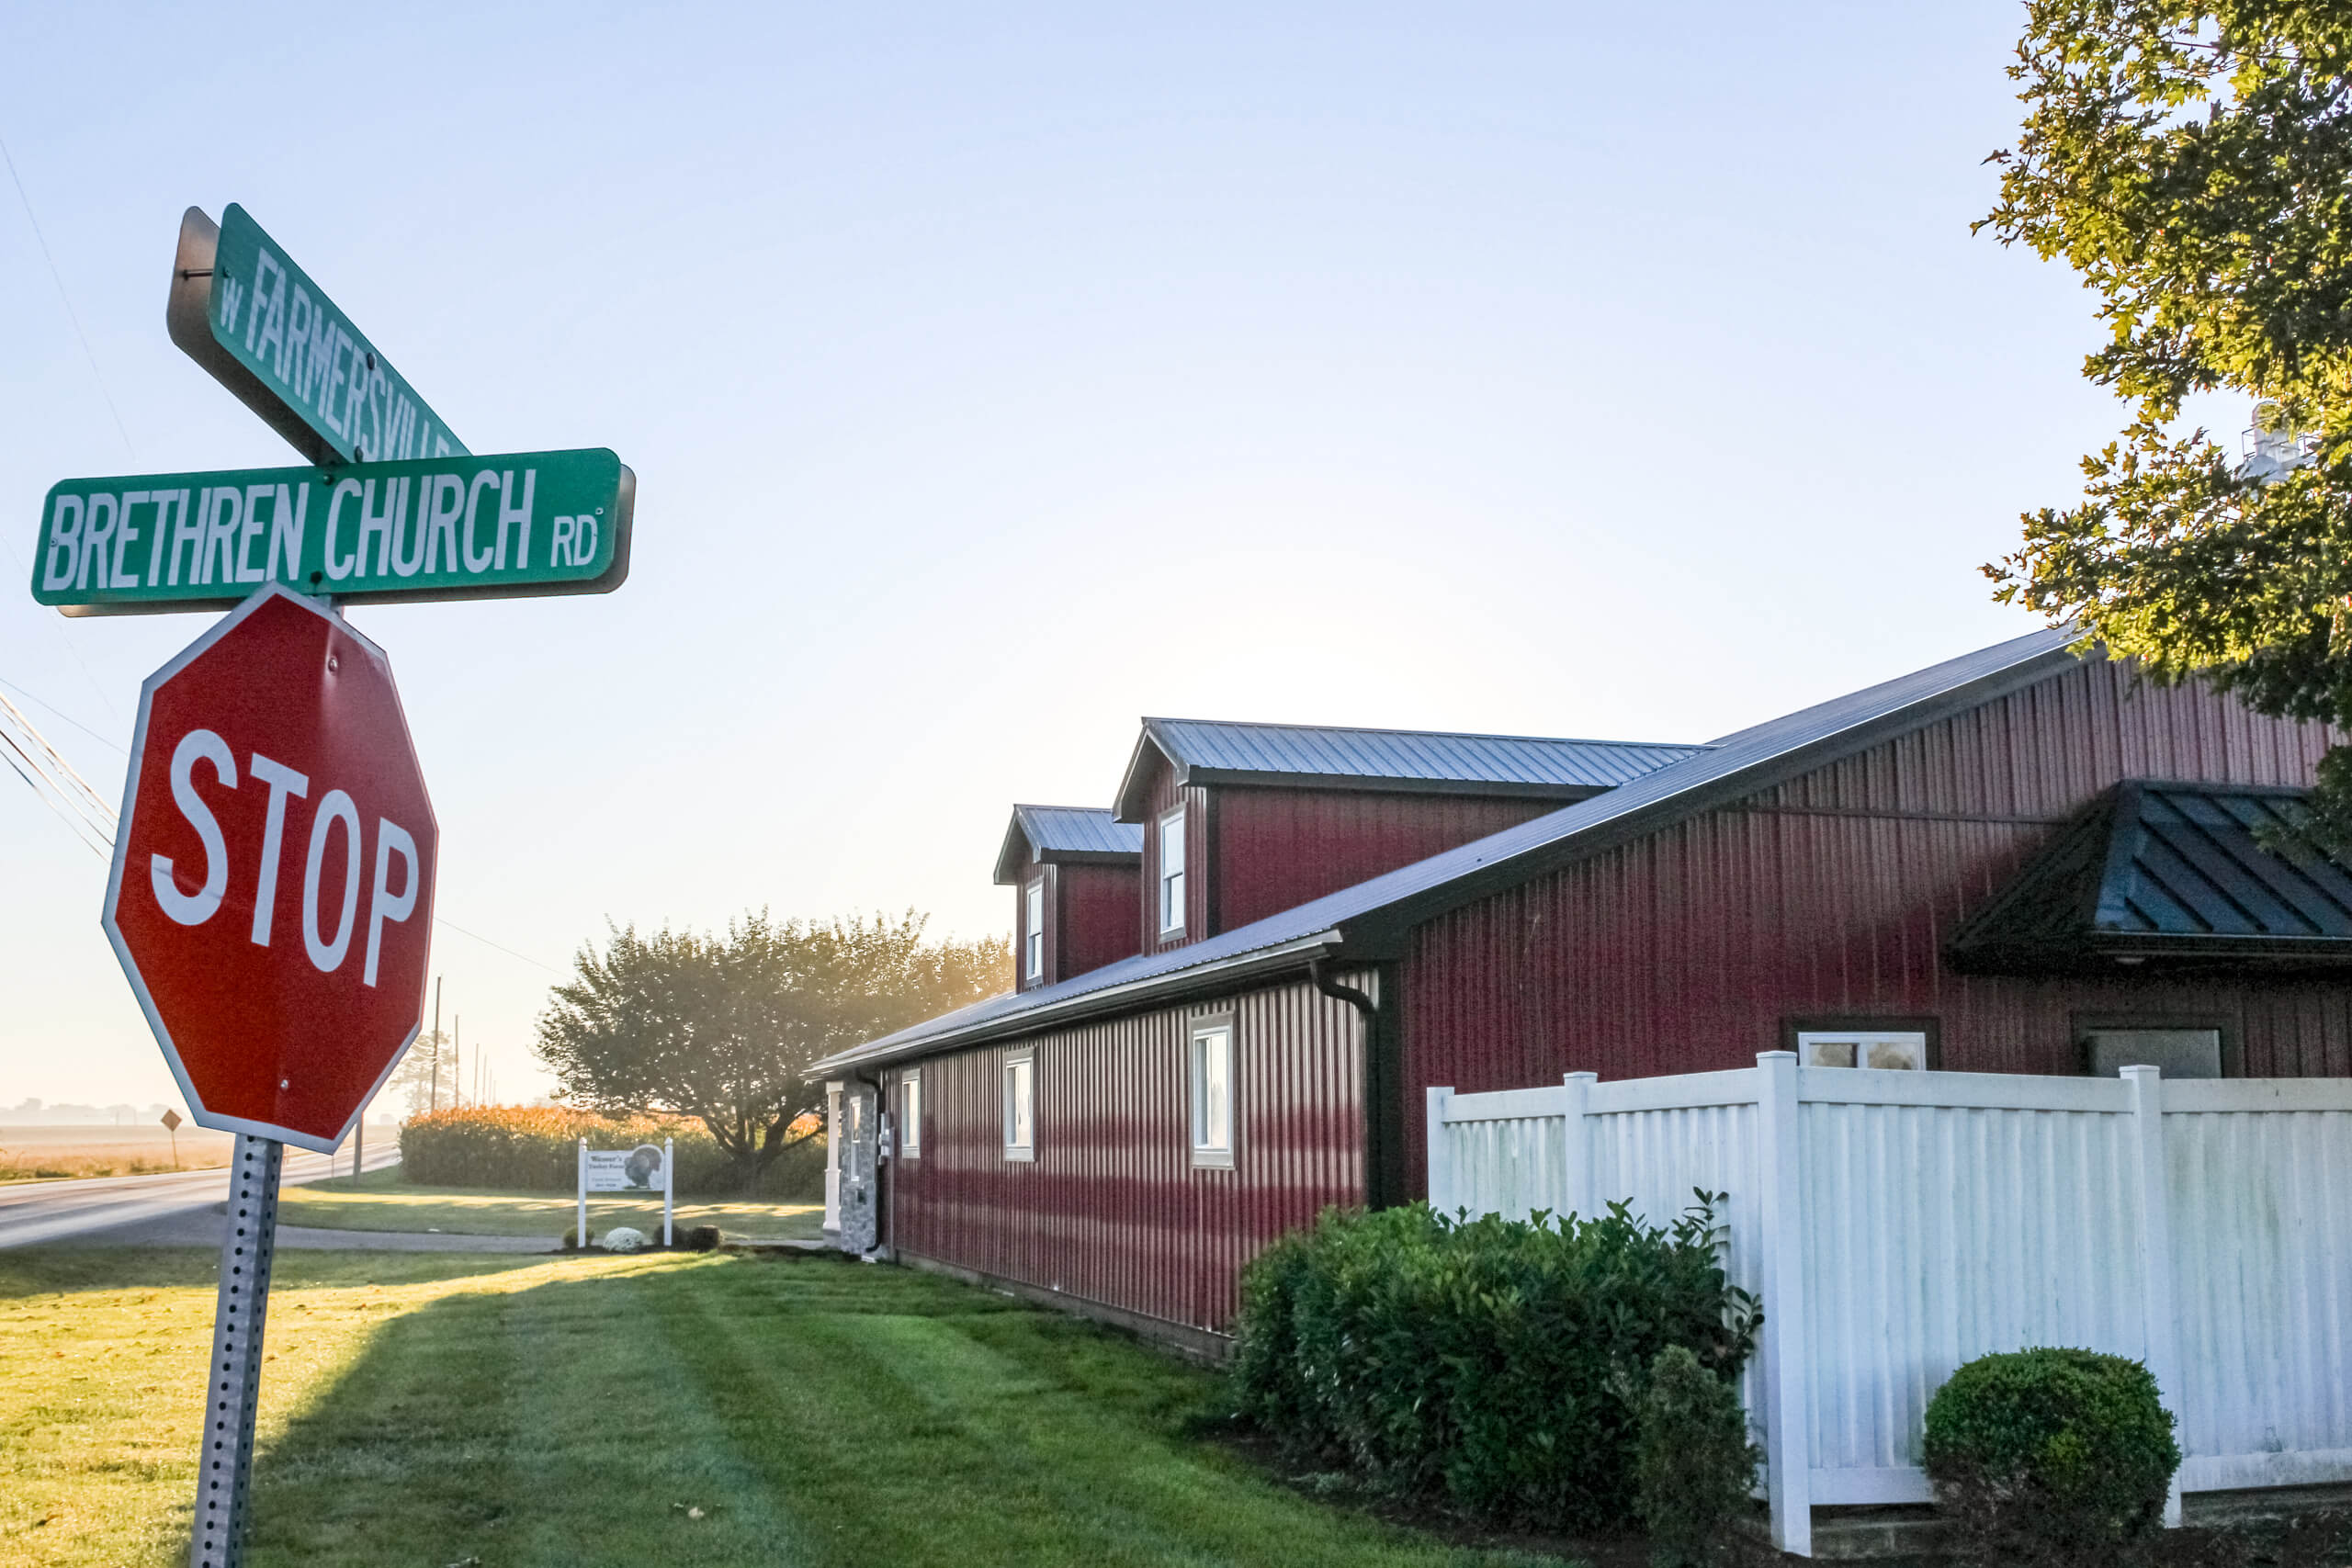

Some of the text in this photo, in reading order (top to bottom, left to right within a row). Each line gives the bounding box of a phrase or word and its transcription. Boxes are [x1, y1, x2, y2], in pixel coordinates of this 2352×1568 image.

[220, 278, 243, 333] W
[42, 469, 598, 591] BRETHREN CHURCH RD
[151, 728, 420, 988] STOP
